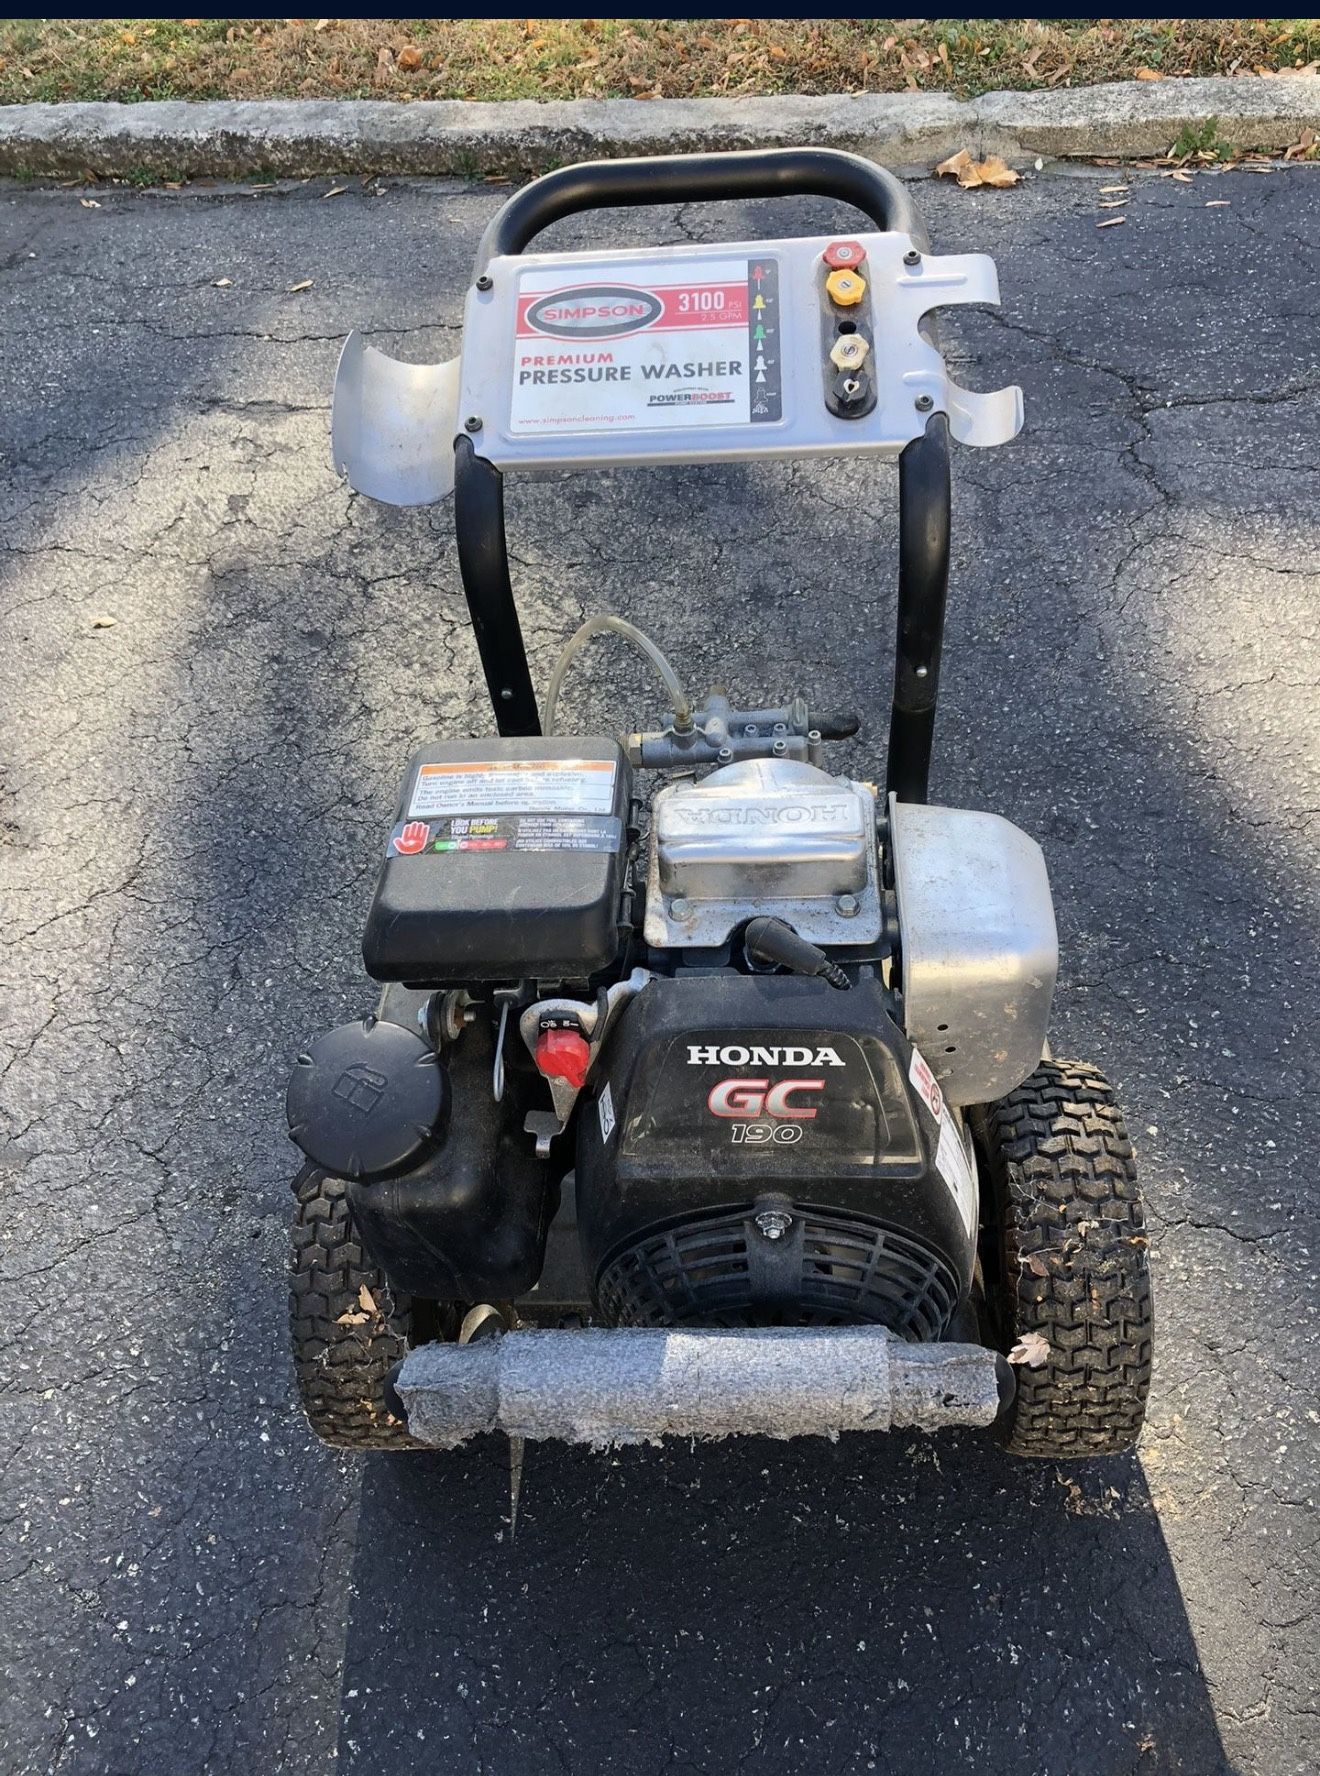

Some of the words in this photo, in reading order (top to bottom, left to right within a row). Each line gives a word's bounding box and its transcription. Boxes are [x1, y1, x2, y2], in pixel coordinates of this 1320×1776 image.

[678, 291, 725, 312] 3100
[728, 301, 742, 309] PSI
[543, 305, 644, 321] SIMPSON
[719, 311, 742, 321] GPM
[521, 352, 614, 366] PREMIUM
[519, 366, 631, 385] PRESSURE
[640, 360, 742, 380] WASHER
[649, 392, 732, 402] POWERBOOST
[517, 414, 635, 425] www.simpsoncleaning.com
[673, 804, 849, 826] HONDA
[450, 826, 468, 834] YOU
[469, 825, 498, 833] PUMP!
[686, 1045, 846, 1067] HONDA
[708, 1078, 826, 1119] GC
[731, 1124, 804, 1144] 190
